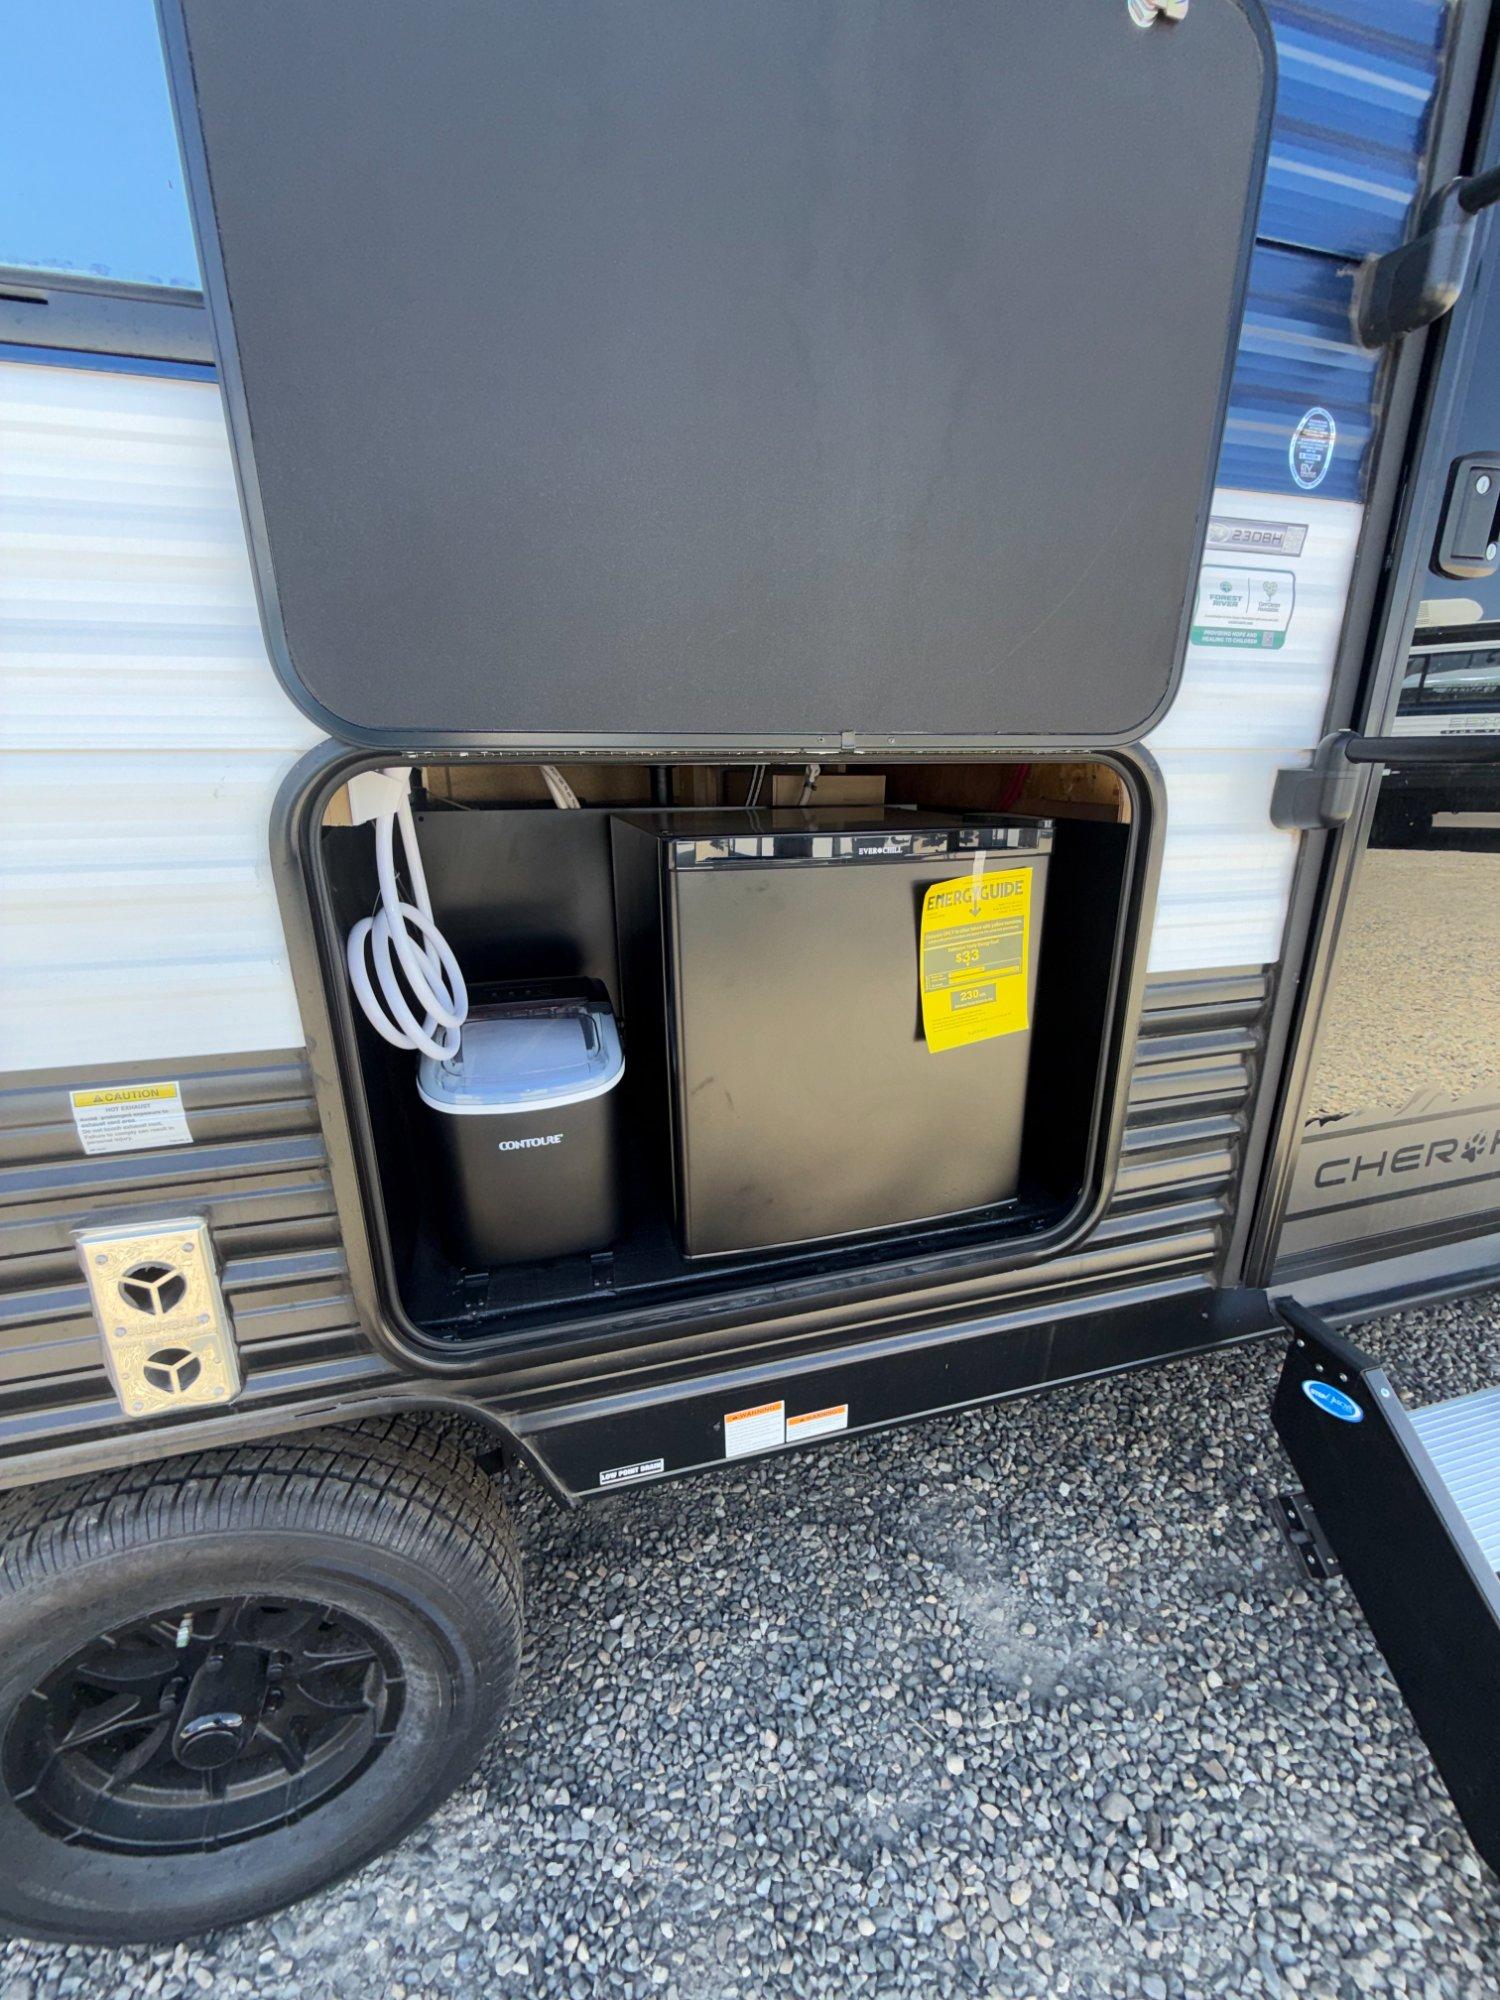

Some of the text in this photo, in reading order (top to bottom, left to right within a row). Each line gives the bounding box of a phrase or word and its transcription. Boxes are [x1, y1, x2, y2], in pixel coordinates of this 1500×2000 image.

[1209, 594, 1243, 602] FOREST
[1212, 600, 1239, 608] RIVER
[954, 948, 981, 964] $33
[959, 989, 980, 1002] 230
[104, 1088, 160, 1102] CAUTION
[120, 1103, 152, 1111] EXHAUST
[601, 1462, 663, 1481] LOW POINT DRAIN
